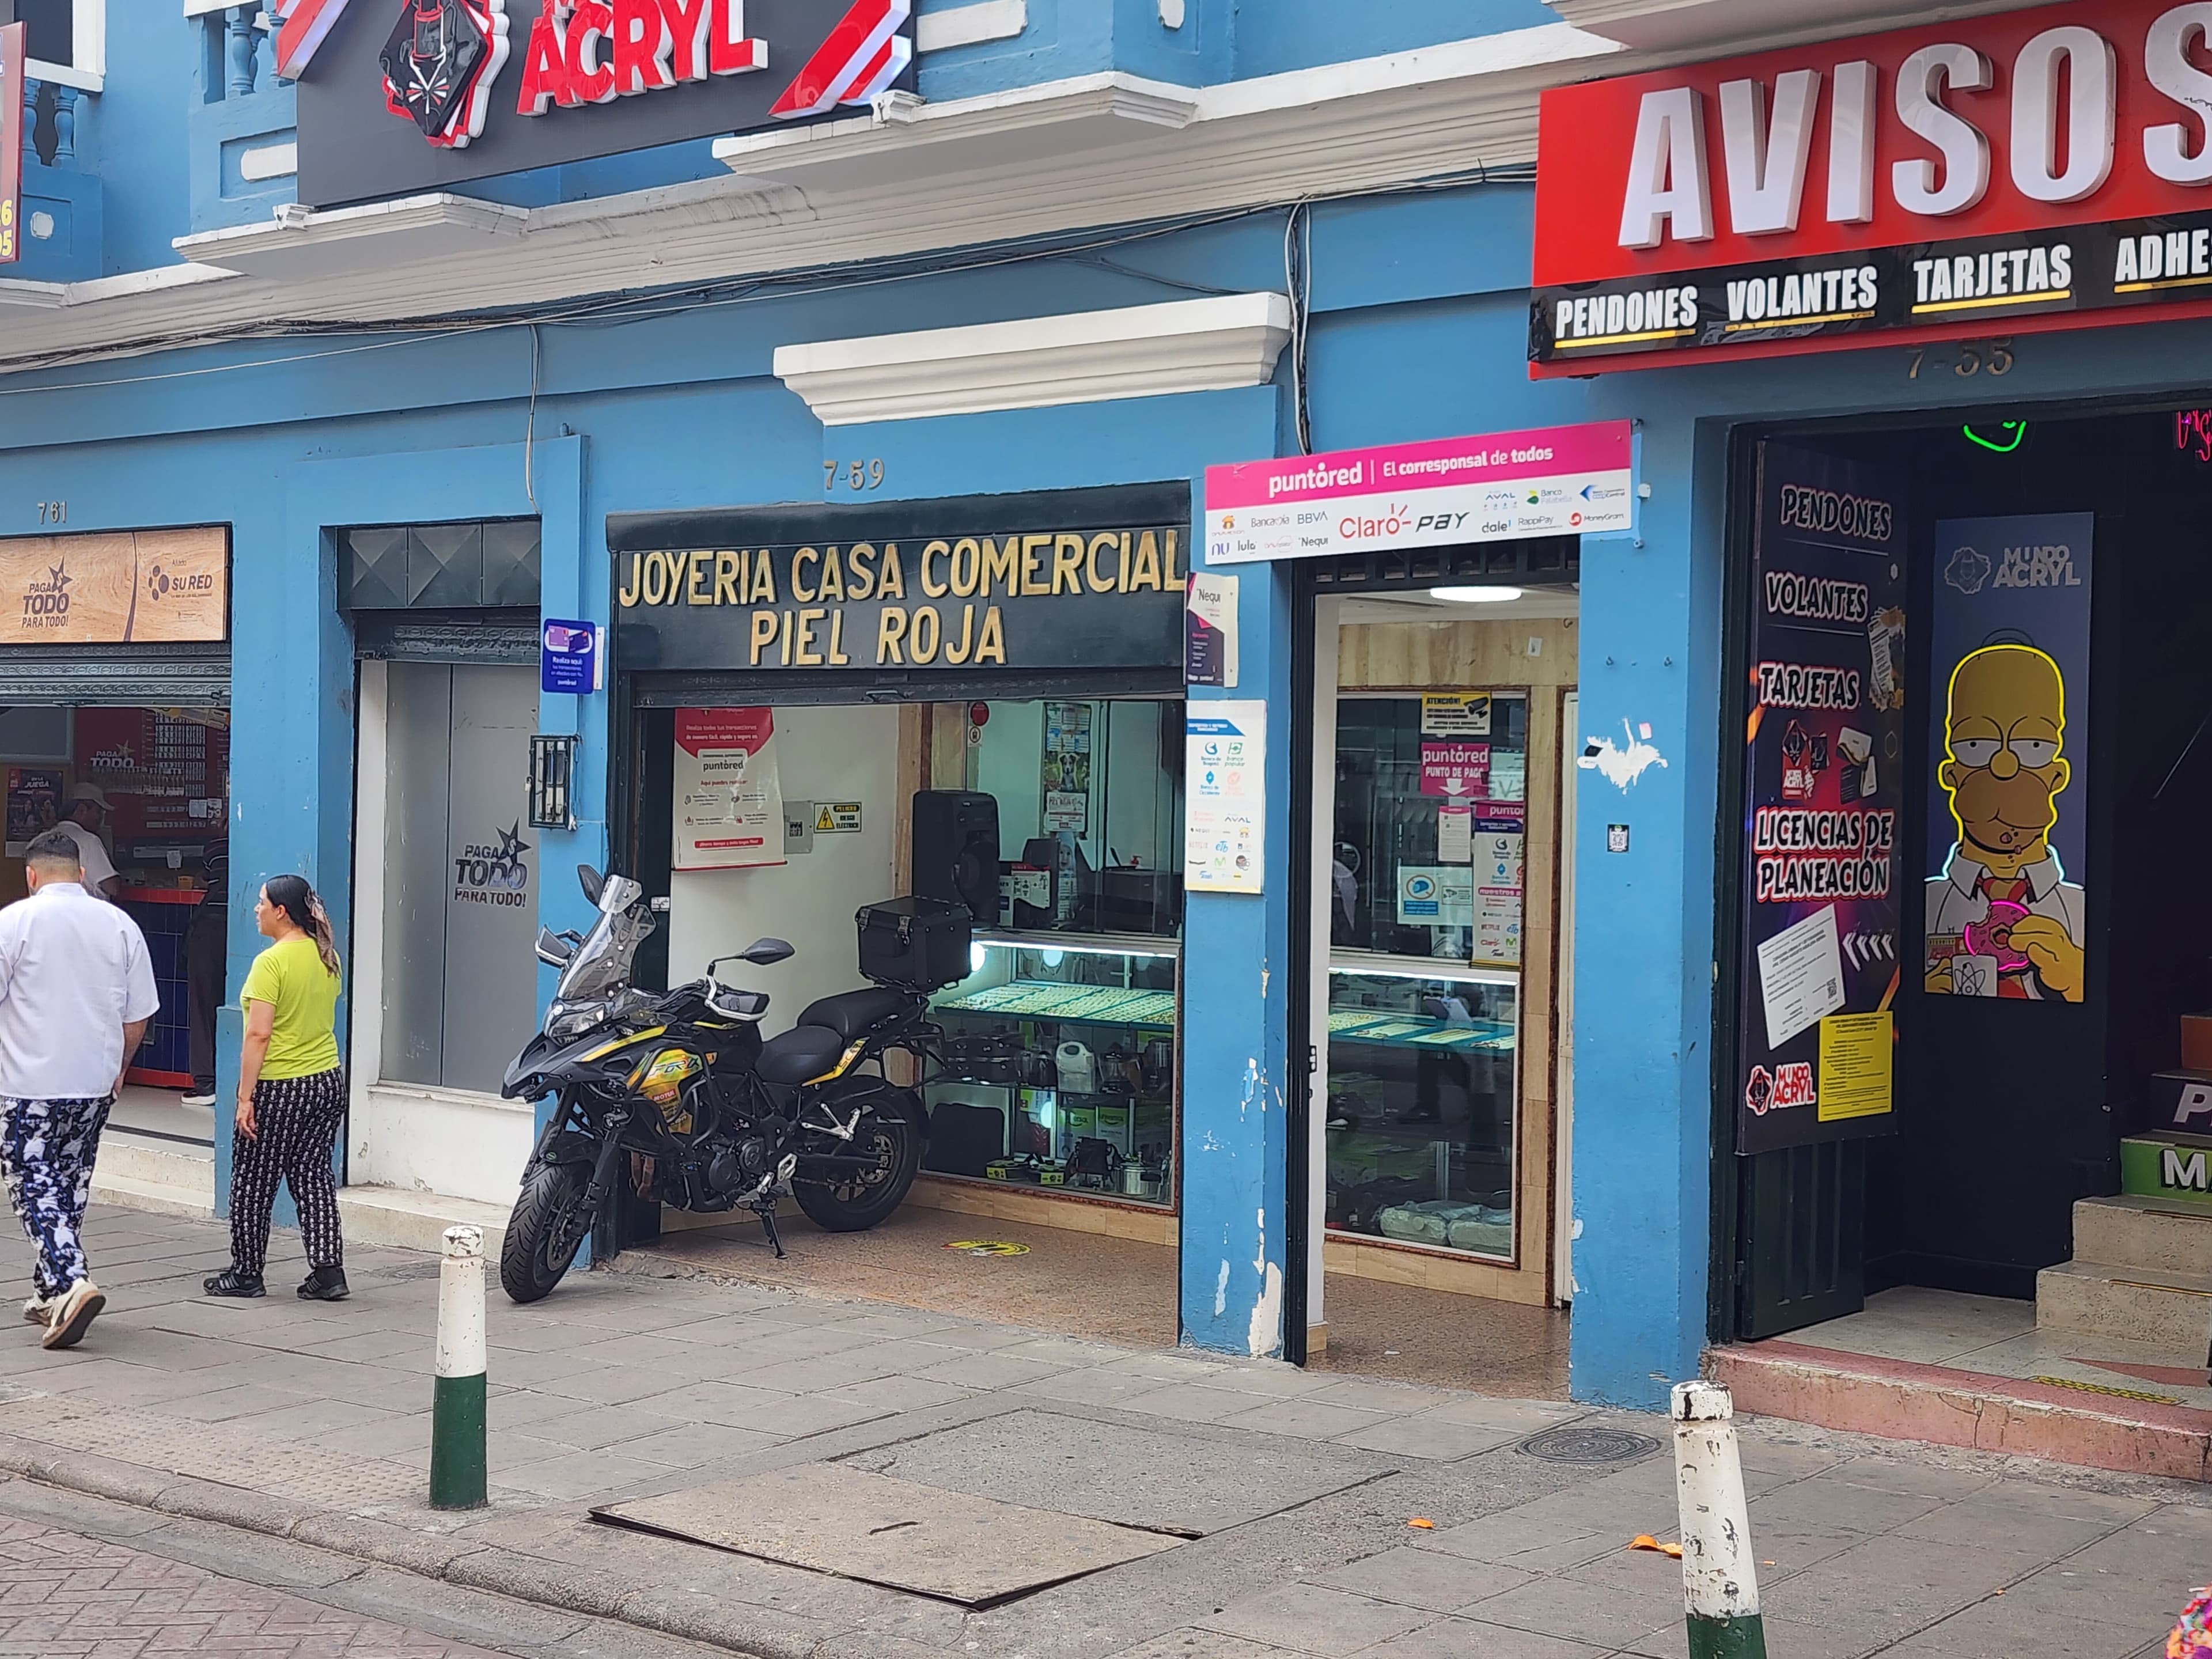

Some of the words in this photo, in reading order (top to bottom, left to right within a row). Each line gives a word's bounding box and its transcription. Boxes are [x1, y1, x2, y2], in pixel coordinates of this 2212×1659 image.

[517, 0, 768, 116] ACRYL
[1618, 2, 2212, 250] AVISOS
[1555, 286, 1699, 339] PENDONES
[1726, 266, 1878, 322] VOLANTES
[1913, 244, 2071, 302] TARJETAS
[2114, 229, 2212, 282] ADHE
[1383, 461, 1396, 476] El
[1399, 450, 1487, 475] corresponsal
[1490, 449, 1509, 465] de
[1511, 445, 1554, 463] todos
[1269, 461, 1363, 498] puntored
[1297, 511, 1328, 524] BBVA
[1780, 484, 1892, 540] PENDONES
[1339, 515, 1402, 540] Claro
[1238, 539, 1256, 551] lulo
[1300, 537, 1328, 548] Nequi
[2004, 545, 2070, 563] MUNDO
[619, 548, 776, 607] JOYERIA
[791, 542, 906, 602] CASA
[922, 529, 1187, 599] COMERCIAL
[1992, 562, 2081, 588] ACRYL
[29, 582, 54, 594] PAGA
[172, 577, 187, 591] SU
[188, 574, 213, 590] RED
[23, 593, 69, 615] TODO
[1198, 589, 1221, 604] Nequi
[1765, 572, 1869, 623] VOLANTES
[22, 616, 44, 628] PARA
[45, 615, 69, 628] TODO!
[749, 608, 849, 667] PIEL
[875, 604, 1006, 665] ROJA
[1758, 661, 1861, 710] TARJETAS
[90, 757, 134, 768] TODO
[703, 759, 744, 772] puntored
[1422, 744, 1489, 766] puntored
[1425, 767, 1450, 777] PUNTO
[1452, 767, 1462, 777] DE
[1755, 808, 1862, 853] LICENCIAS
[1863, 809, 1894, 851] DE
[464, 844, 499, 859] PAGA
[455, 859, 527, 890] TODO
[1758, 849, 1890, 902] PLANEACIÓN
[454, 887, 488, 904] PARA
[489, 892, 527, 908] TODO!
[1777, 1063, 1810, 1082] MUNDO
[653, 1089, 675, 1101] MOTUL
[1771, 1080, 1815, 1107] ACRYL
